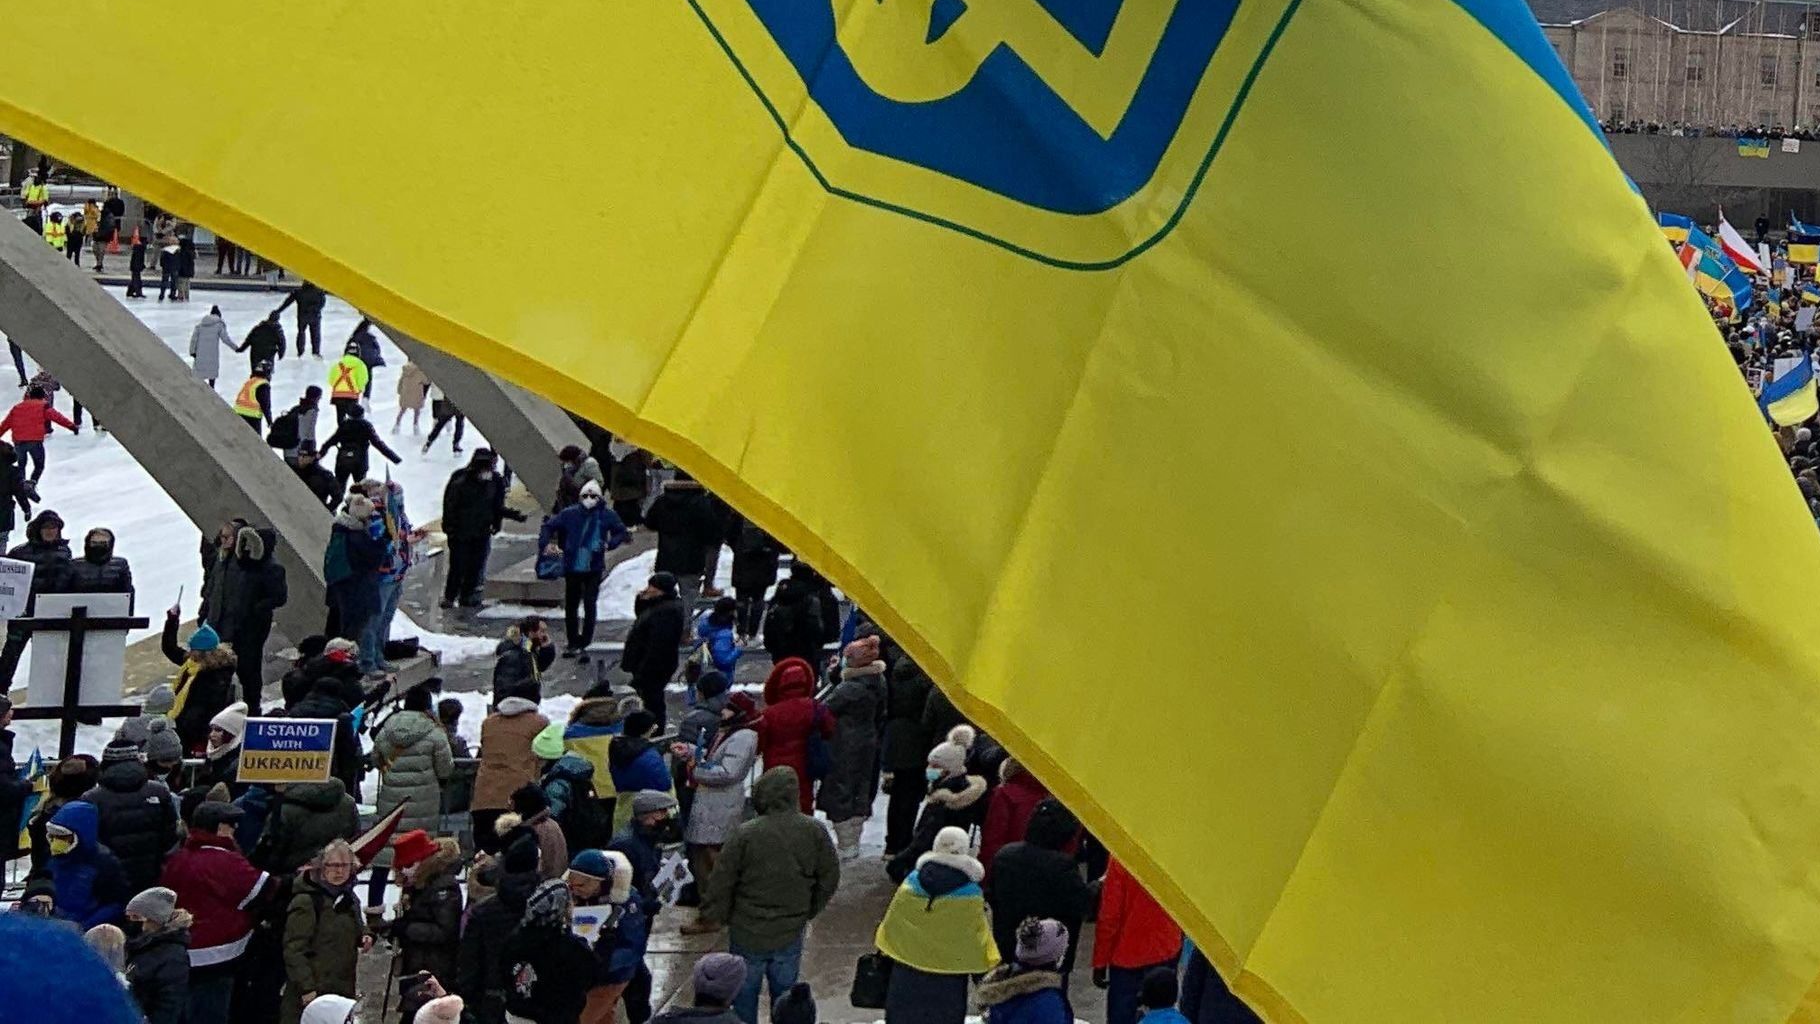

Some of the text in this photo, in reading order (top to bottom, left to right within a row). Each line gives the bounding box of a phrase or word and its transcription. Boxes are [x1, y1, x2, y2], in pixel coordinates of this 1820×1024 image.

[258, 724, 320, 737] I STAND
[272, 739, 302, 749] WITH
[243, 756, 327, 770] UKRAINE
